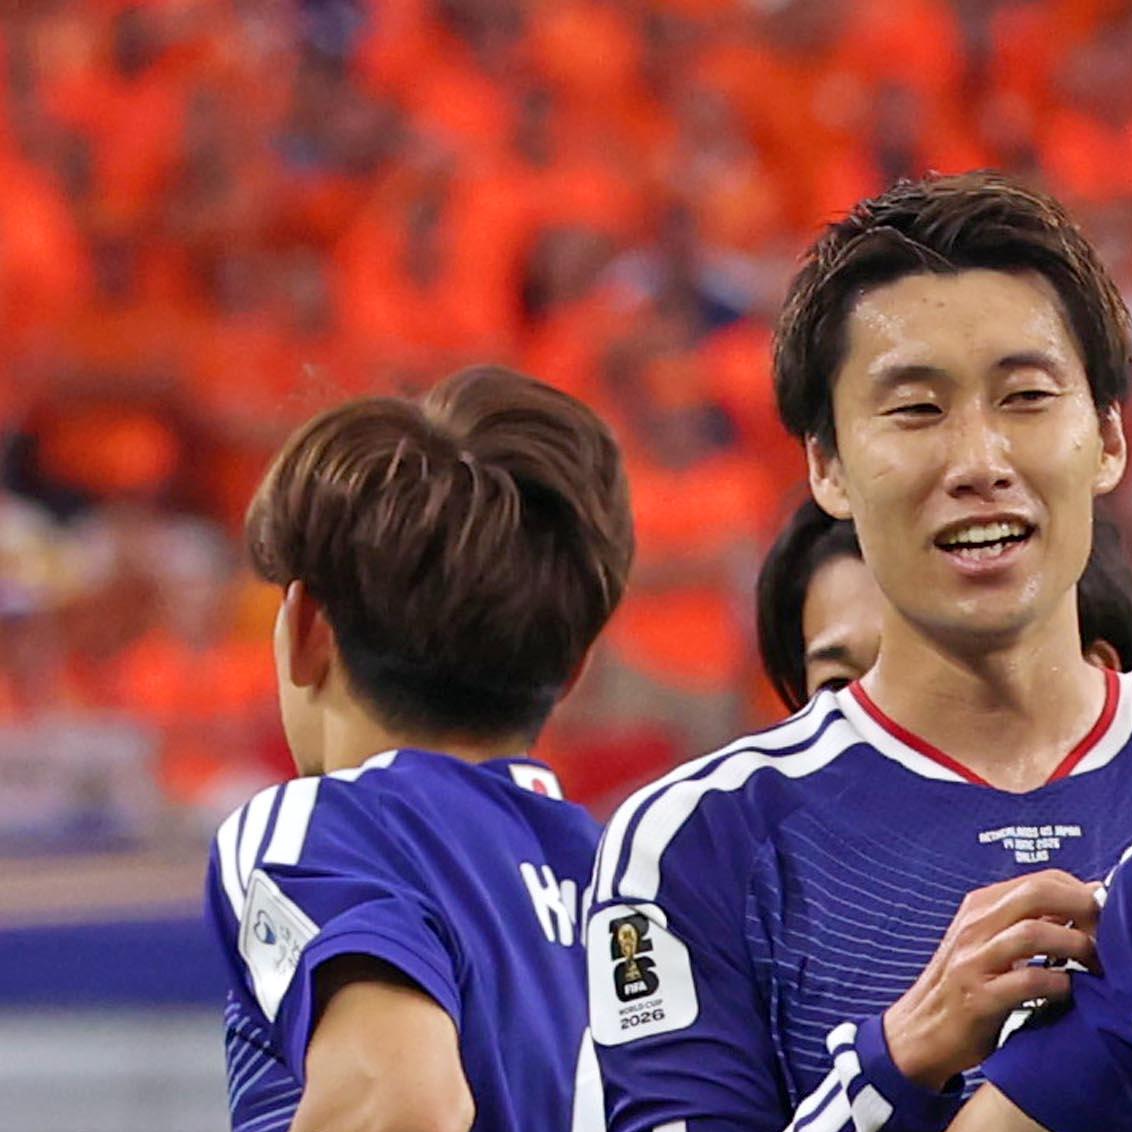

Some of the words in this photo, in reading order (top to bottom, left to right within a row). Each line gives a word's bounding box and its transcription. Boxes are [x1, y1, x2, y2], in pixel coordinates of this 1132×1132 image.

[1015, 850, 1049, 863] DALLAS
[624, 980, 648, 996] FIFA
[619, 1003, 644, 1015] WORLD
[645, 999, 663, 1009] CUP
[620, 1008, 665, 1030] 2026
